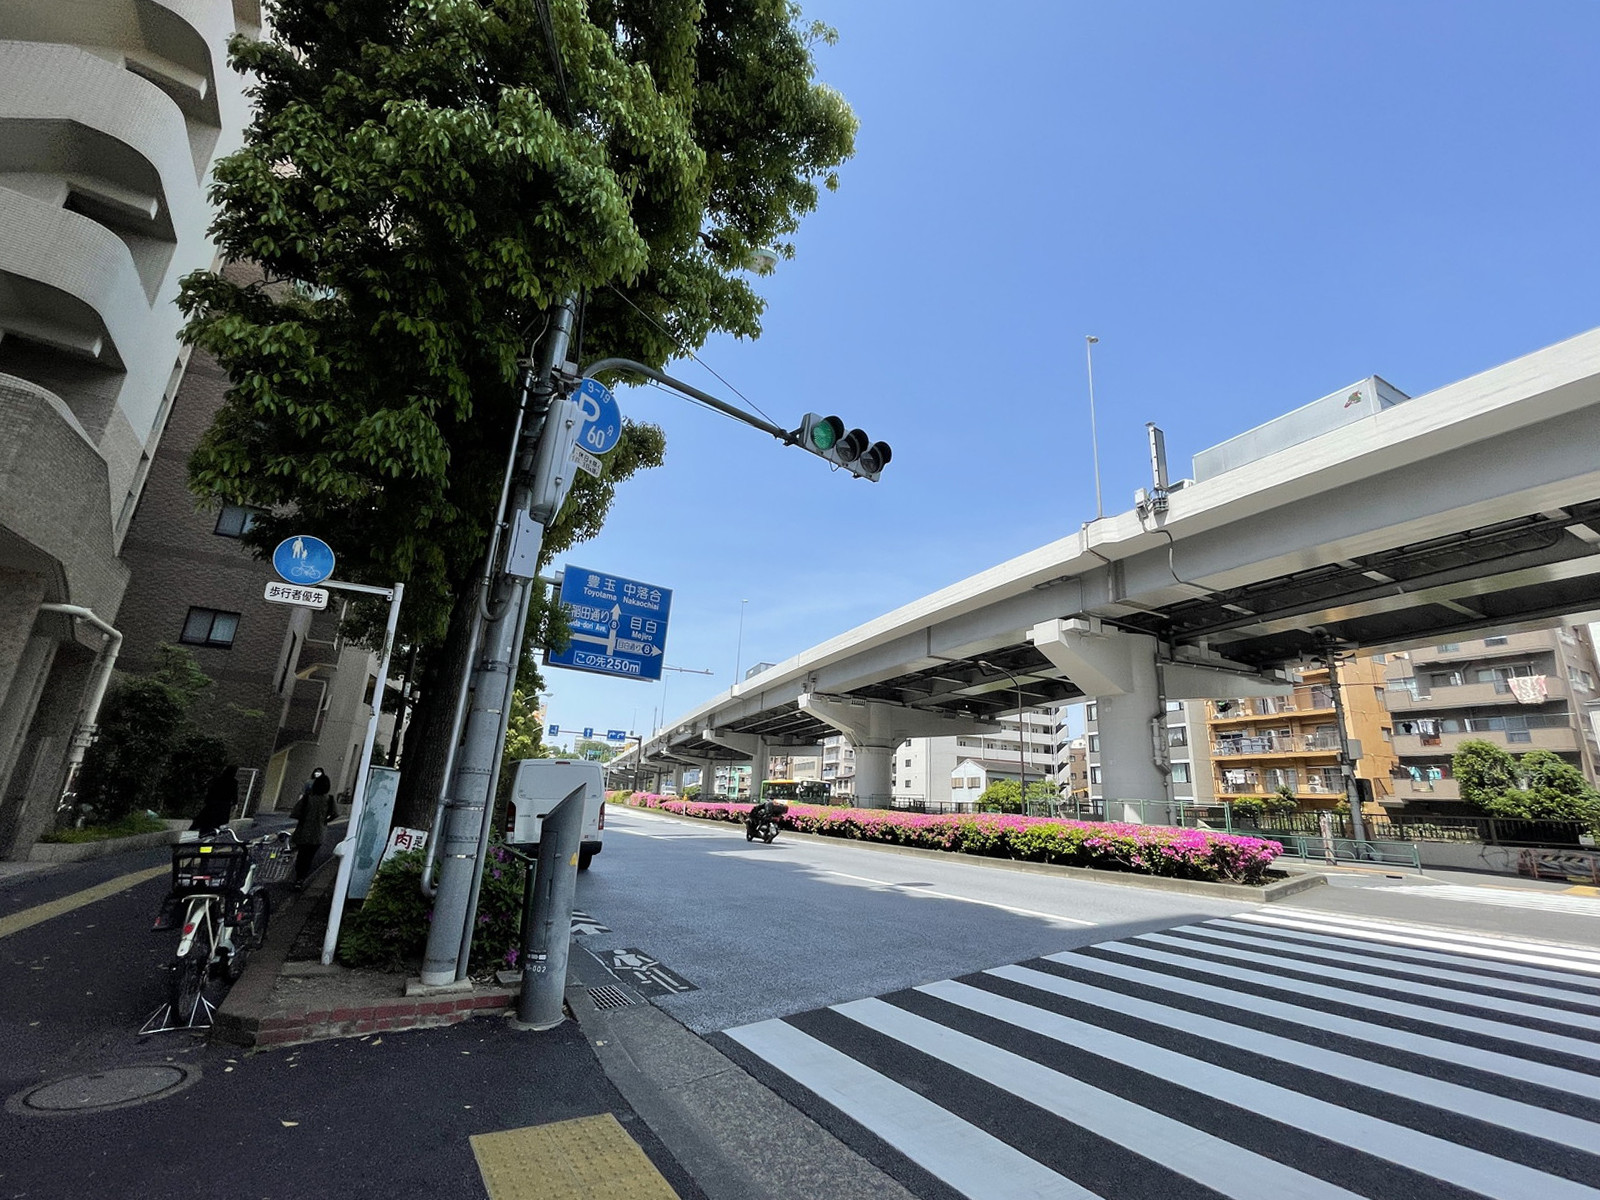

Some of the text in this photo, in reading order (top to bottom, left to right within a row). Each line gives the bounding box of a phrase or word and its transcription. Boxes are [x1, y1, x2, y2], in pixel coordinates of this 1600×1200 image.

[587, 574, 616, 592] 豊玉
[269, 586, 323, 604] 歩行者優先
[583, 586, 618, 602] Toyotama
[624, 583, 662, 603] 中落合
[622, 596, 660, 610] Nakaochiai
[630, 616, 657, 634] 目白
[631, 630, 653, 641] Mejiro
[576, 653, 640, 673] この先250m
[394, 829, 413, 850] 肉
